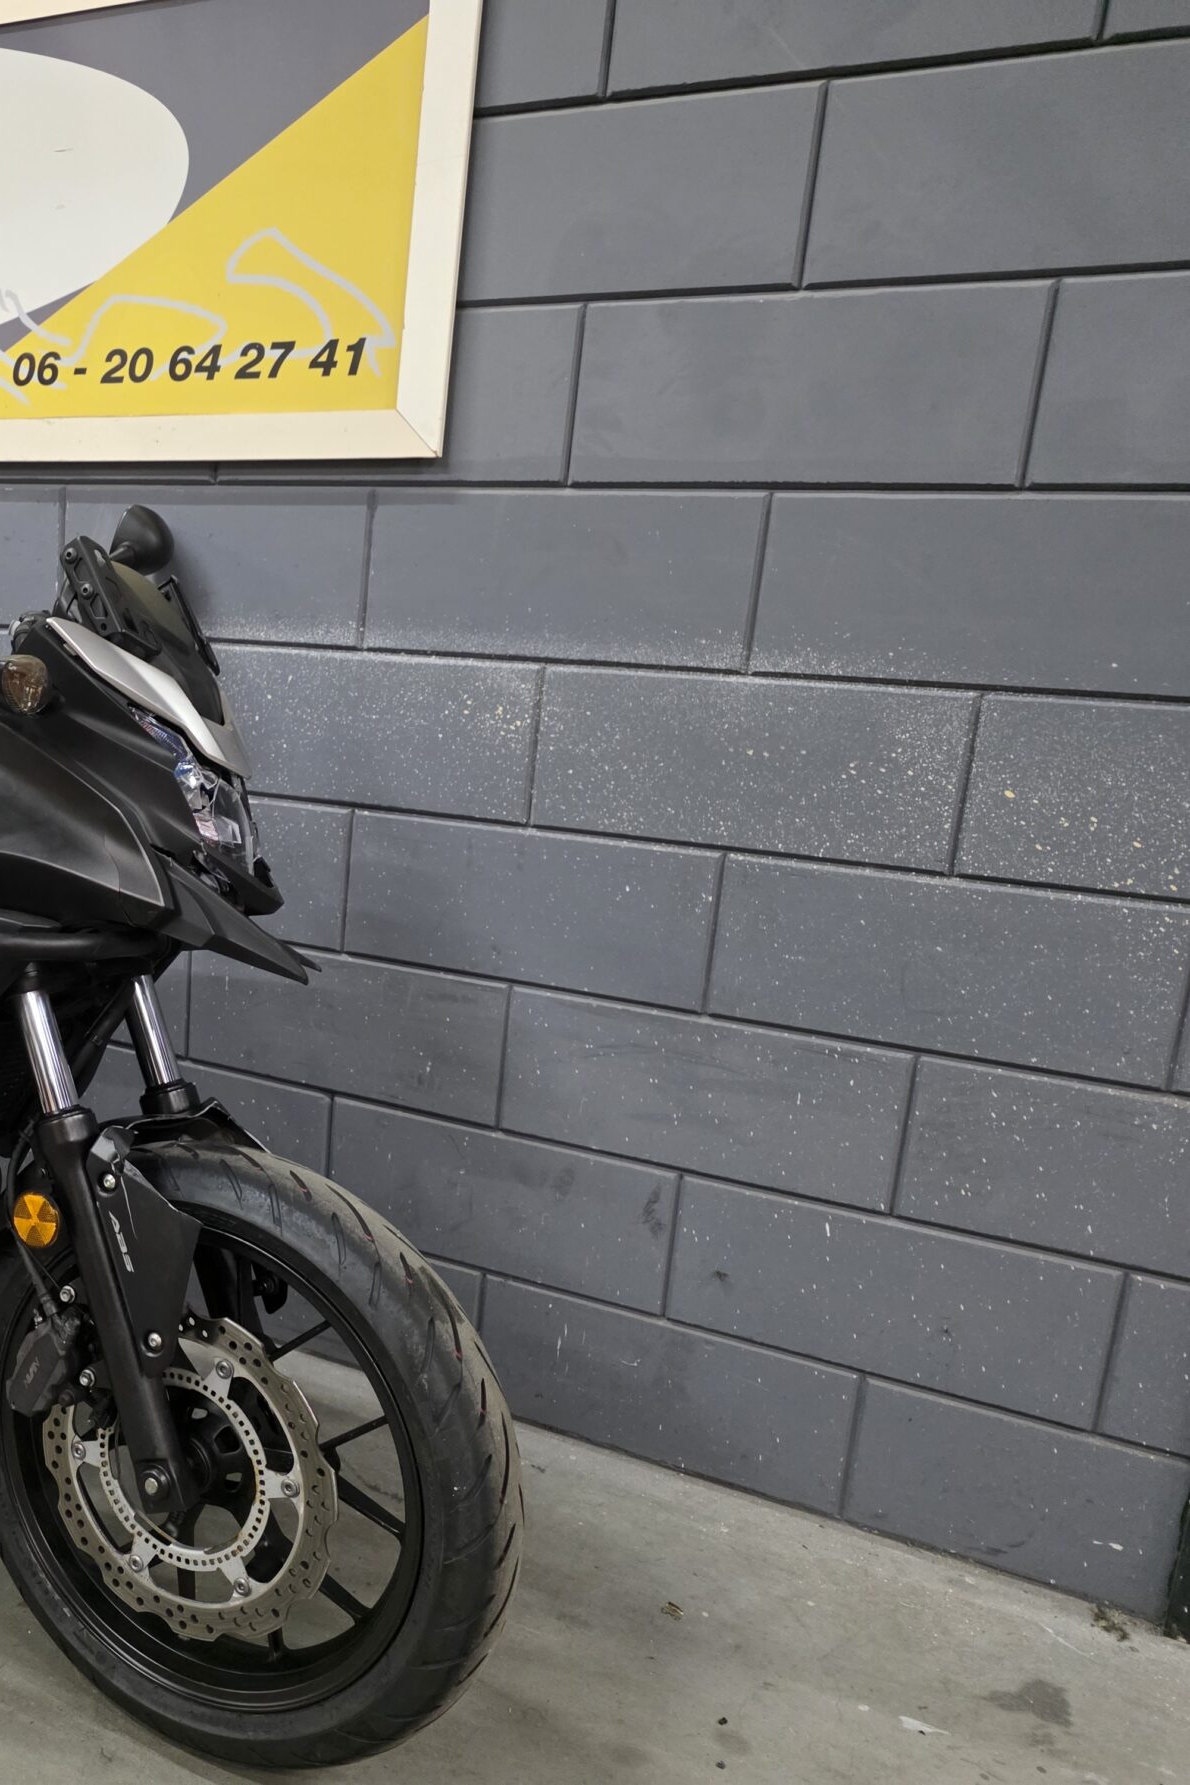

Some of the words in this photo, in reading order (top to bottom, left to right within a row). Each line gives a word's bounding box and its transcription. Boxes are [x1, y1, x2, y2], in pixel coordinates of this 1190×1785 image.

[12, 351, 61, 386] 06
[100, 348, 154, 384] 20
[168, 344, 222, 381] 64
[234, 341, 296, 380] 27
[309, 337, 367, 376] 41
[109, 1210, 135, 1273] ABS
